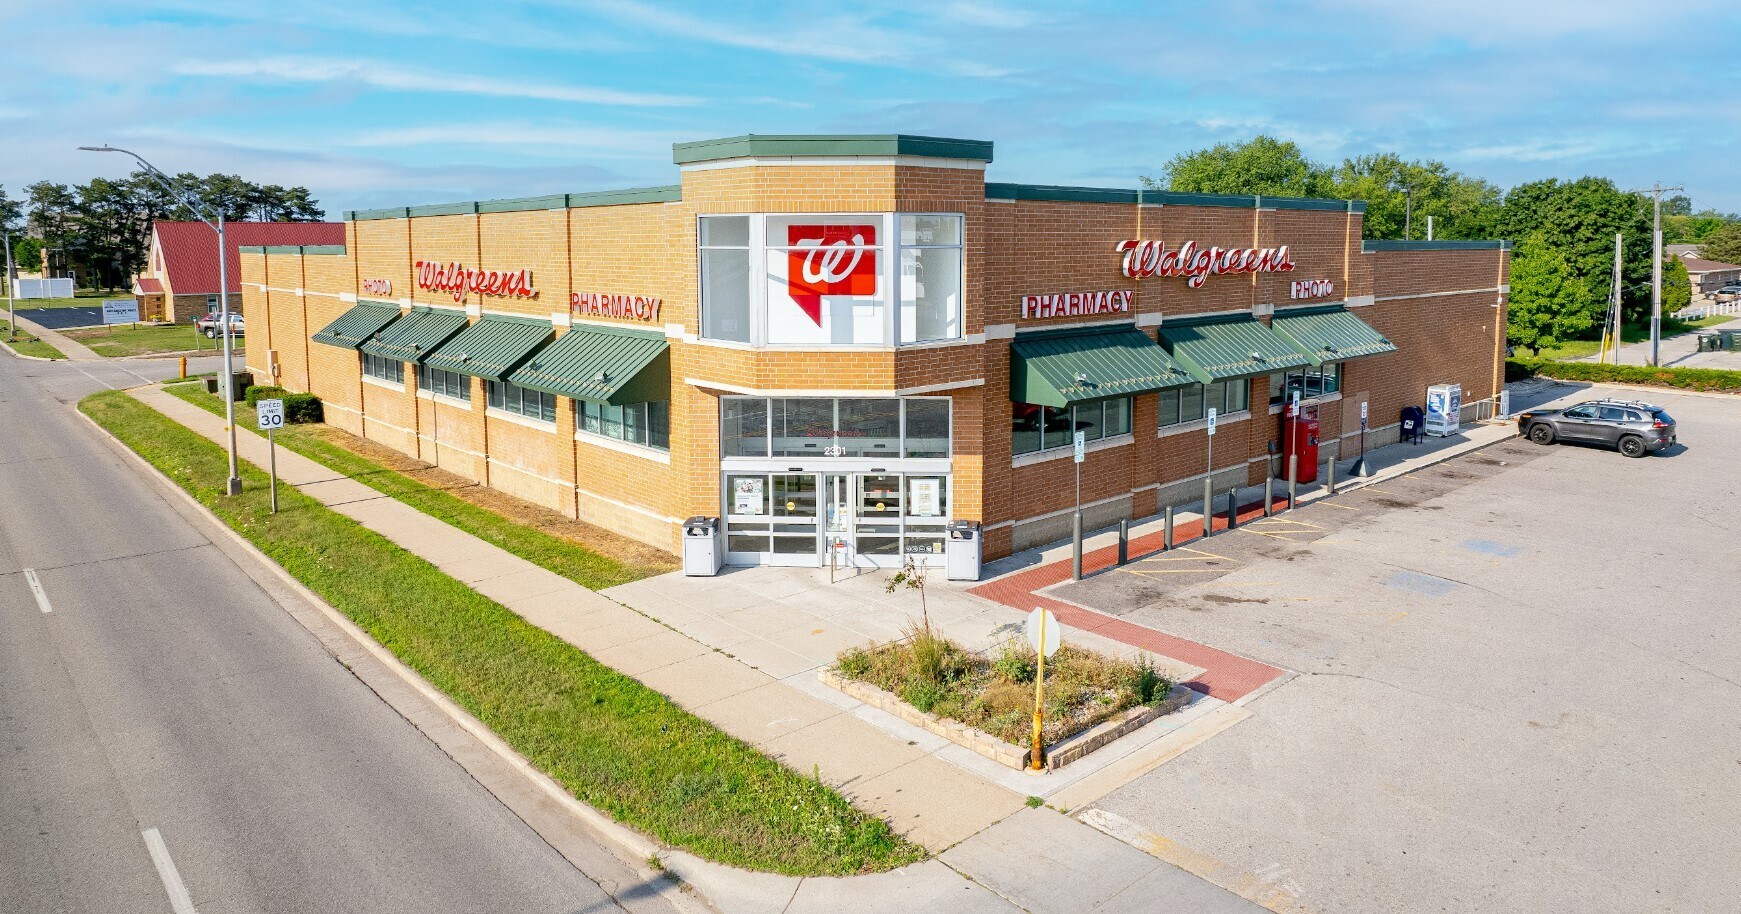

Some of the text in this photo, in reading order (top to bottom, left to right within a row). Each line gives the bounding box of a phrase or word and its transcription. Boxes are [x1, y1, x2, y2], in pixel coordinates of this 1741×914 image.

[797, 234, 864, 284] W
[1116, 240, 1295, 288] Walgreens
[363, 279, 389, 295] PHOTO
[416, 260, 534, 302] Walgreens
[1292, 279, 1334, 299] PHOTO
[572, 292, 660, 321] PHARMACY
[1022, 290, 1134, 319] PHARMACY
[261, 414, 282, 426] 30
[824, 446, 846, 456] 2301
